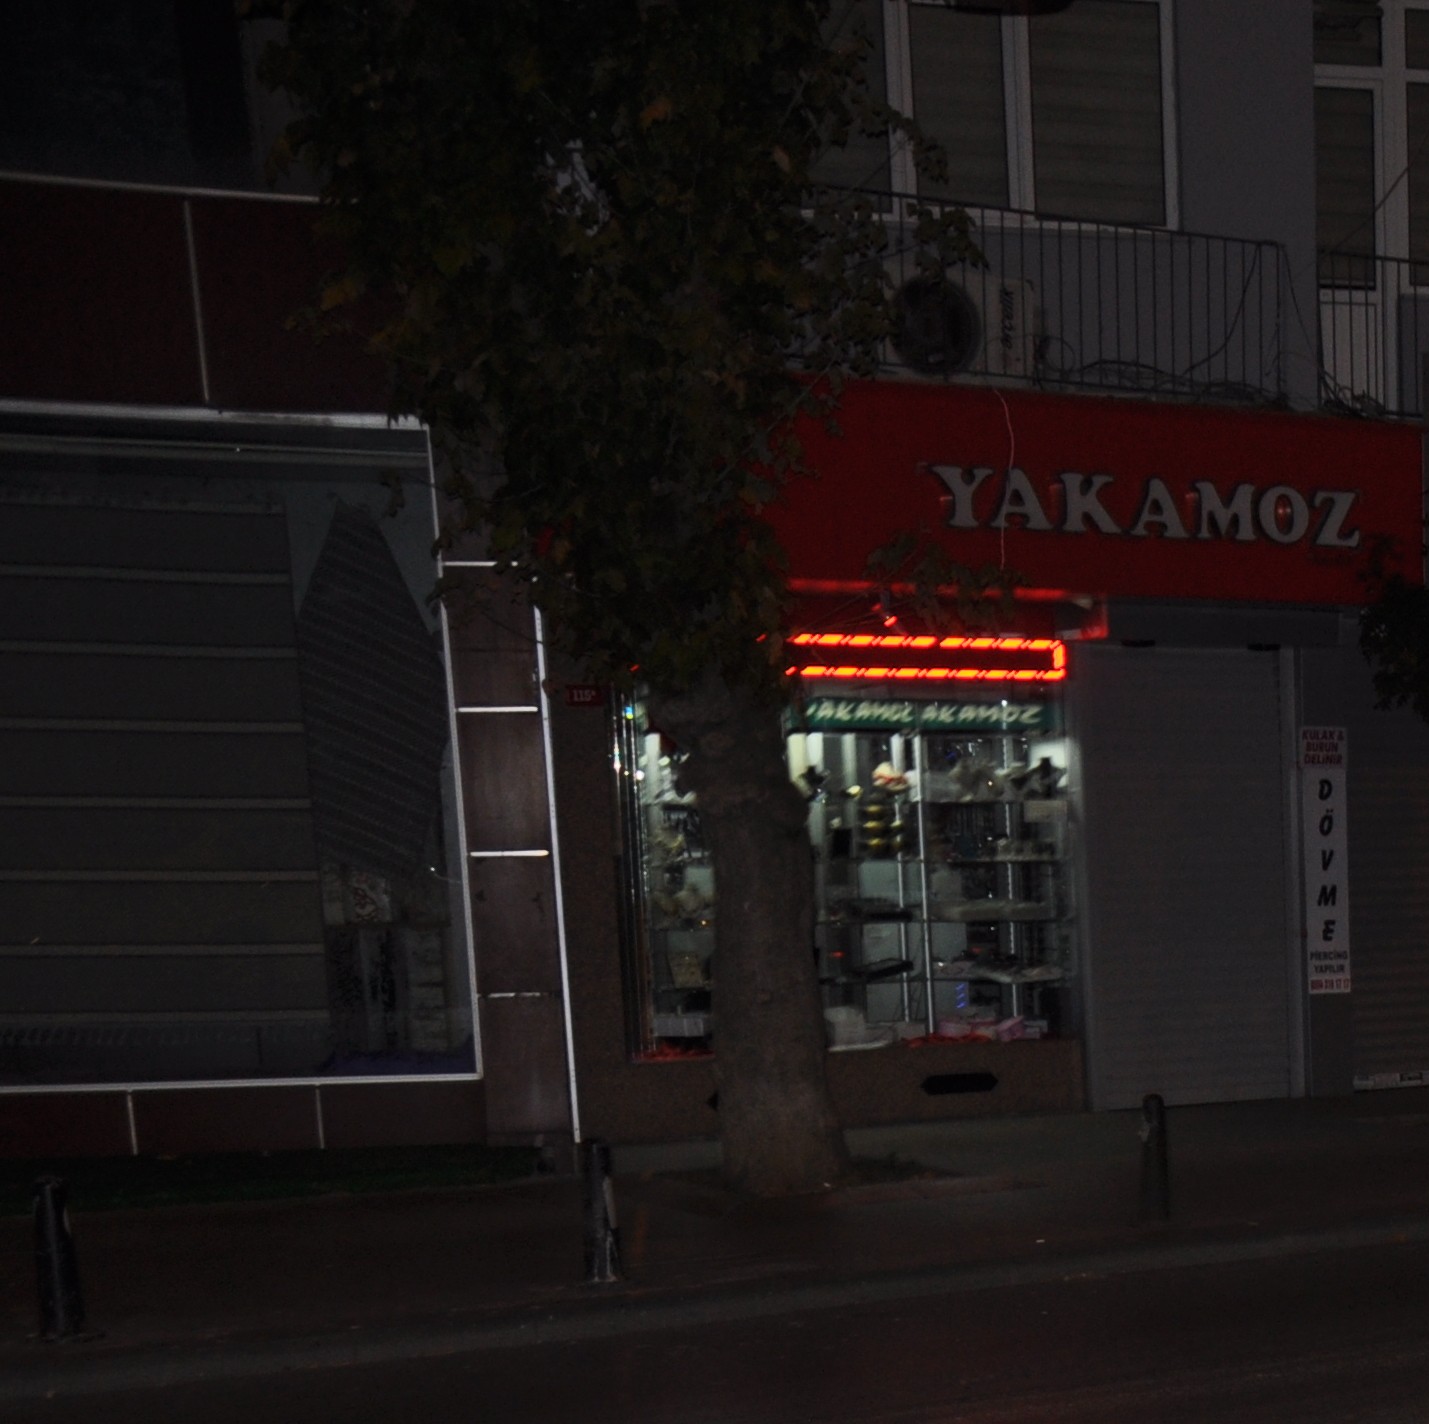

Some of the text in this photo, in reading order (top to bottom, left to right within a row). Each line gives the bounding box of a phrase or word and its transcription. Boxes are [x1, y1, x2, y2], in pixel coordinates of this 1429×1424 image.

[929, 464, 1361, 548] YAKAMOZ
[1302, 729, 1335, 740] KULAK
[1305, 742, 1338, 752] BURUN
[1317, 779, 1337, 942] DÖVME
